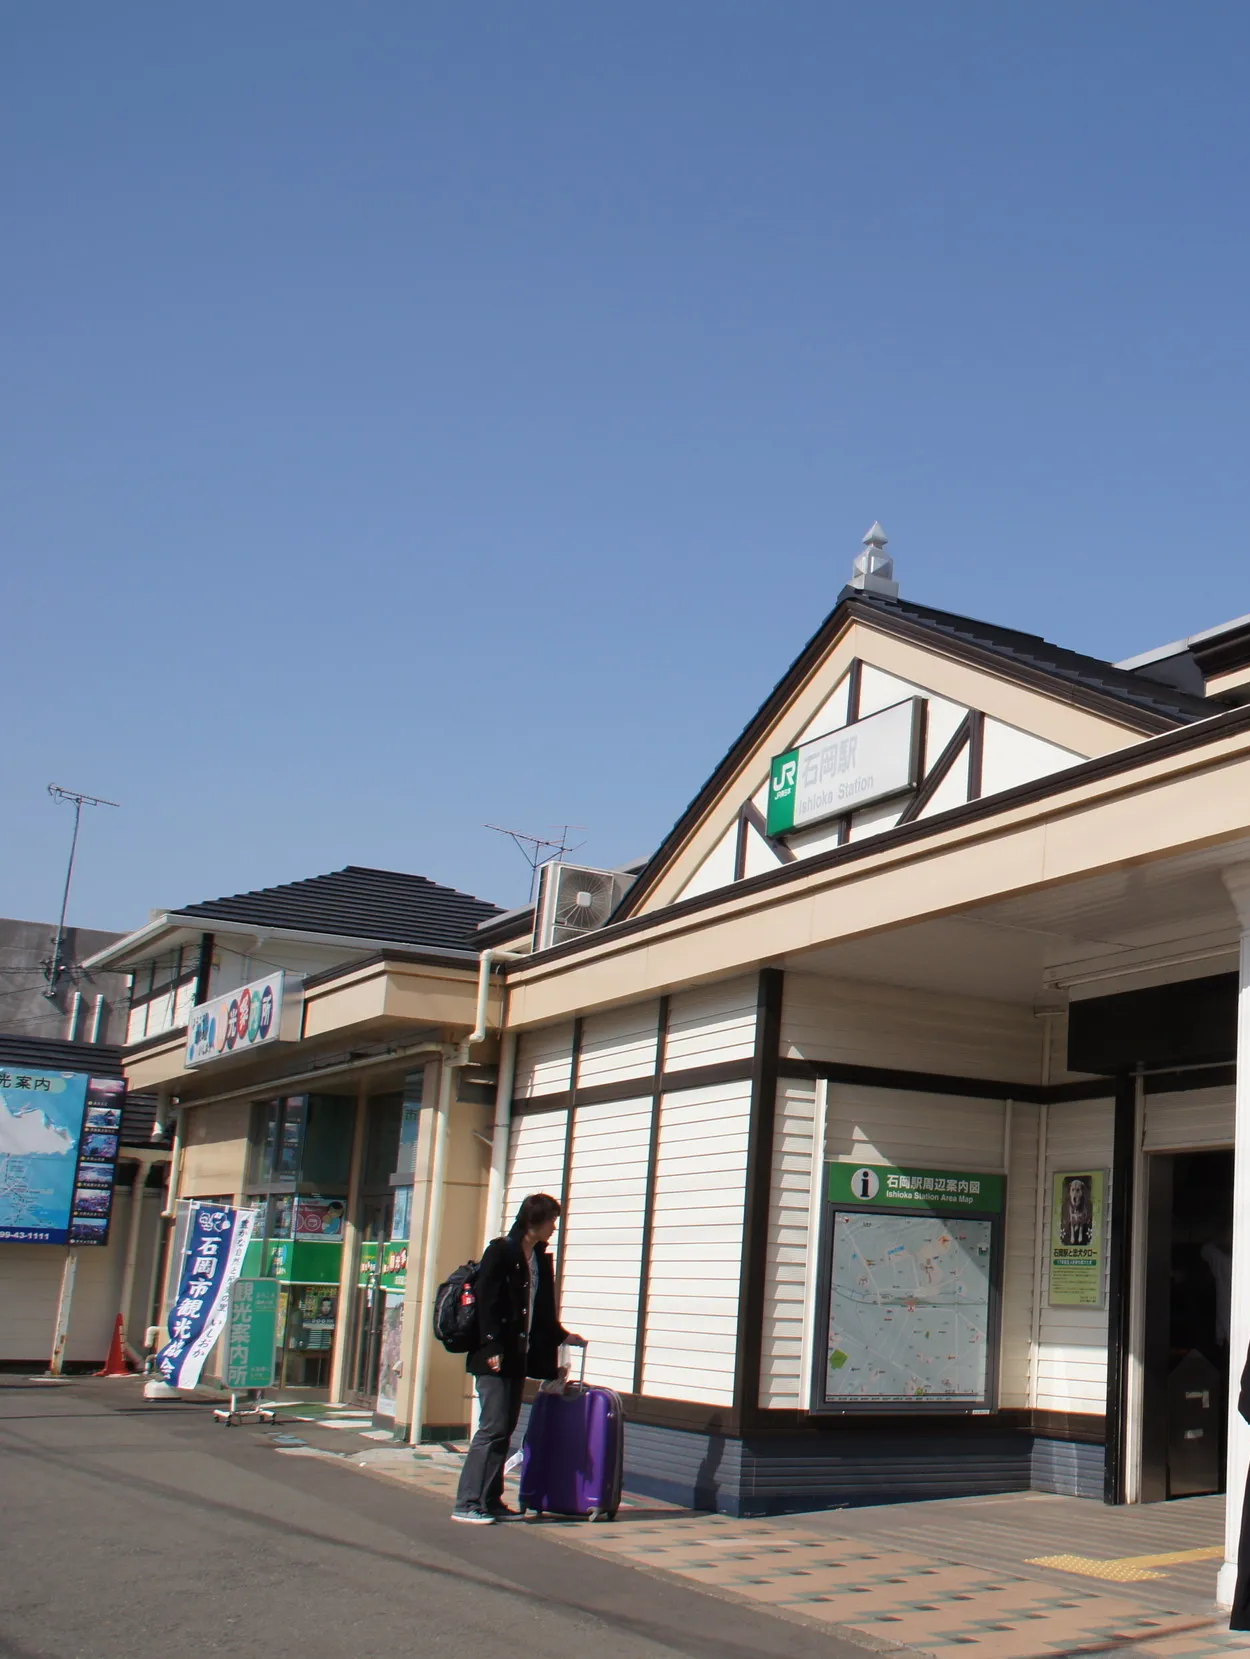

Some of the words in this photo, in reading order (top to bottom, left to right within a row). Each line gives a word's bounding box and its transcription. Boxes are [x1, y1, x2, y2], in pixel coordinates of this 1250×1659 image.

[773, 760, 796, 791] JR
[803, 735, 858, 787] 石岡駅
[799, 791, 833, 815] Ishioka
[838, 775, 874, 801] Station
[886, 1174, 980, 1194] 石岡駅周辺案内図
[886, 1190, 912, 1199] Ishioka
[914, 1191, 939, 1201] Station
[941, 1194, 957, 1202] Area
[959, 1195, 974, 1204] Map
[158, 1236, 222, 1380] 石岡市観光協会
[193, 1318, 222, 1359] いしおか
[228, 1282, 254, 1386] 観光案内所
